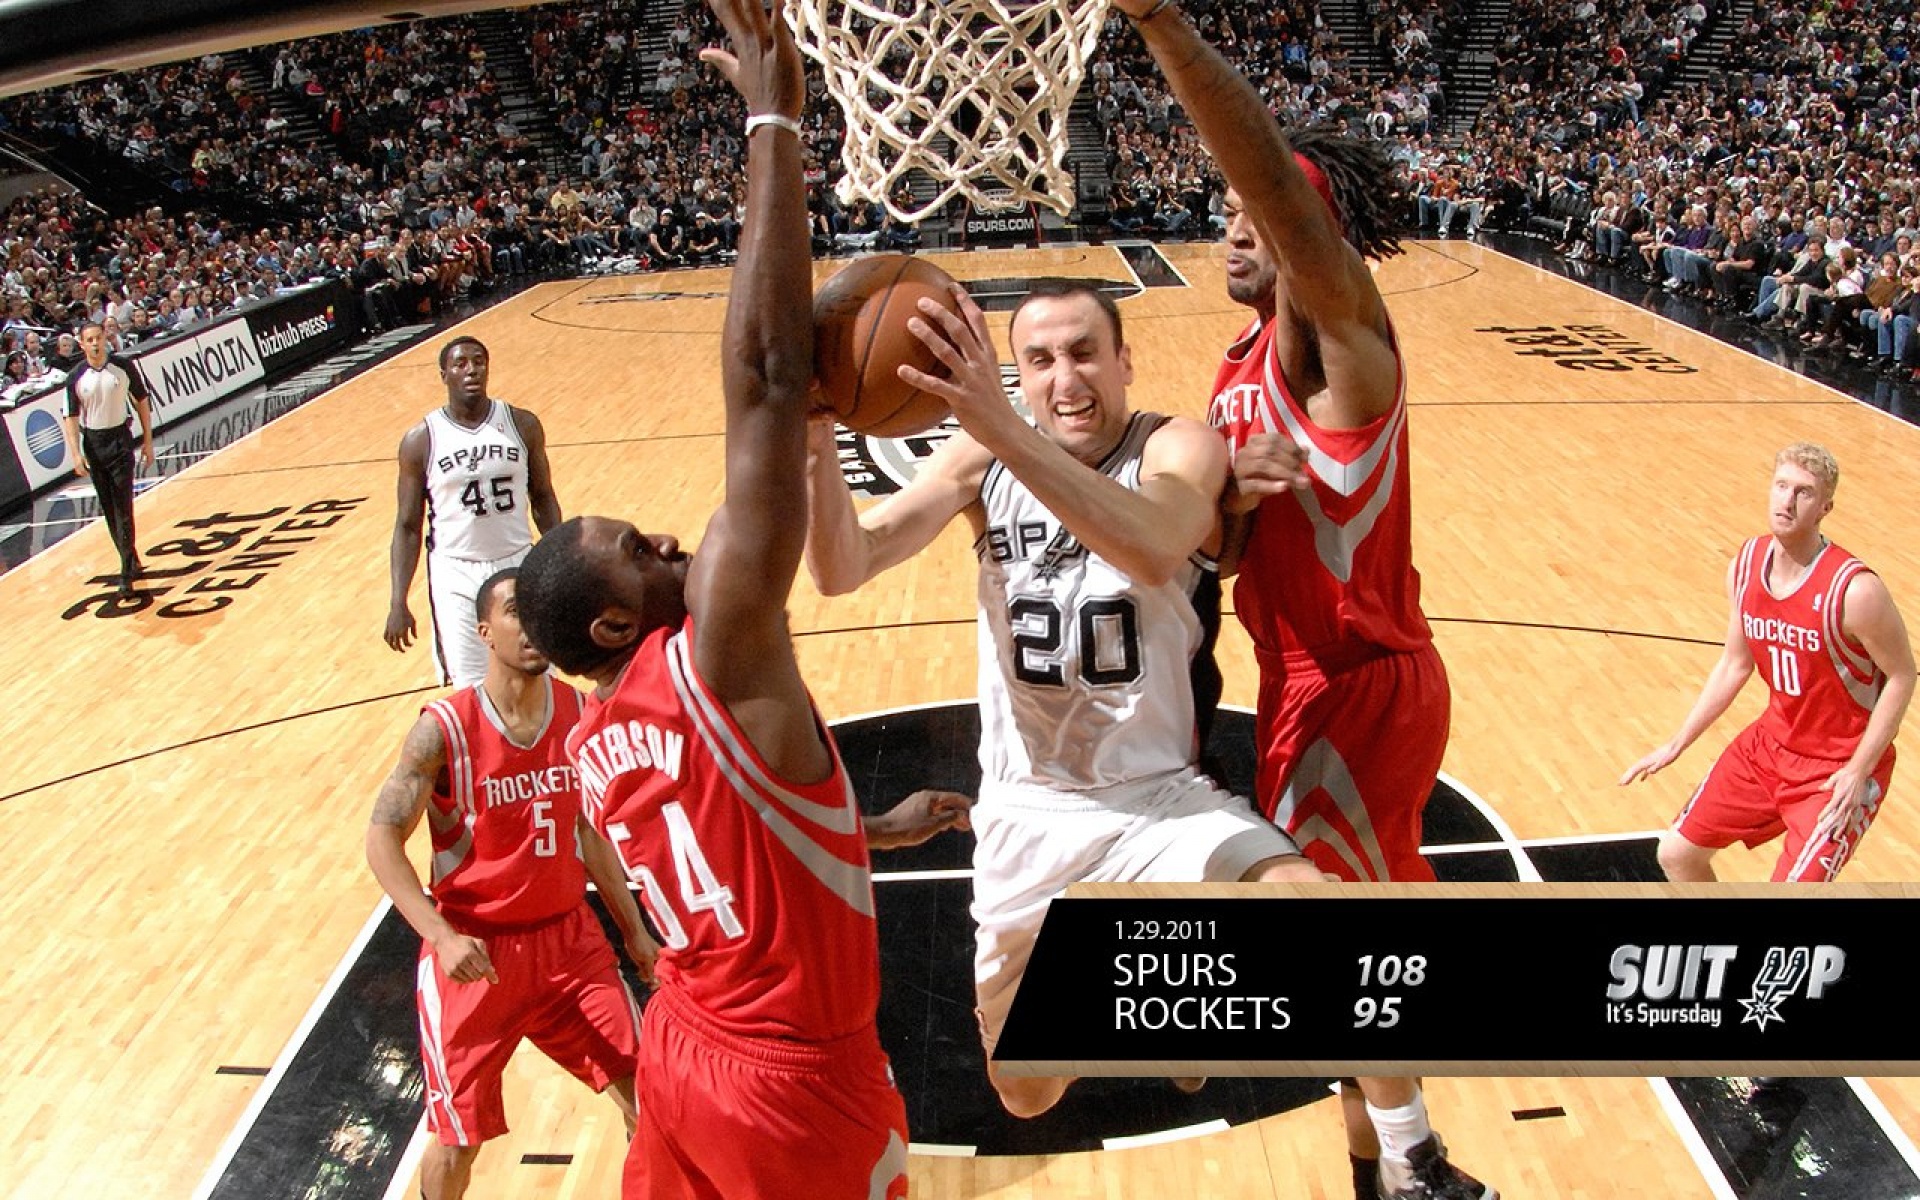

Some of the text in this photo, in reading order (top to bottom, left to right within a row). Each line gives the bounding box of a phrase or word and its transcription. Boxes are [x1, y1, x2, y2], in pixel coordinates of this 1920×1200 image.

[967, 218, 1034, 233] SPURS.COM
[257, 314, 328, 358] bizhub PRESS
[1562, 325, 1699, 373] CENTER
[161, 336, 255, 403] MINOLTA
[438, 444, 520, 473] SPURS
[461, 476, 515, 516] 45
[61, 506, 292, 620] at&t
[156, 496, 370, 618] CENTER
[1008, 594, 1145, 690] 20
[1743, 612, 1820, 652] ROCKETS
[1767, 645, 1802, 697] 10
[532, 800, 556, 857] 5
[606, 801, 744, 950] 54
